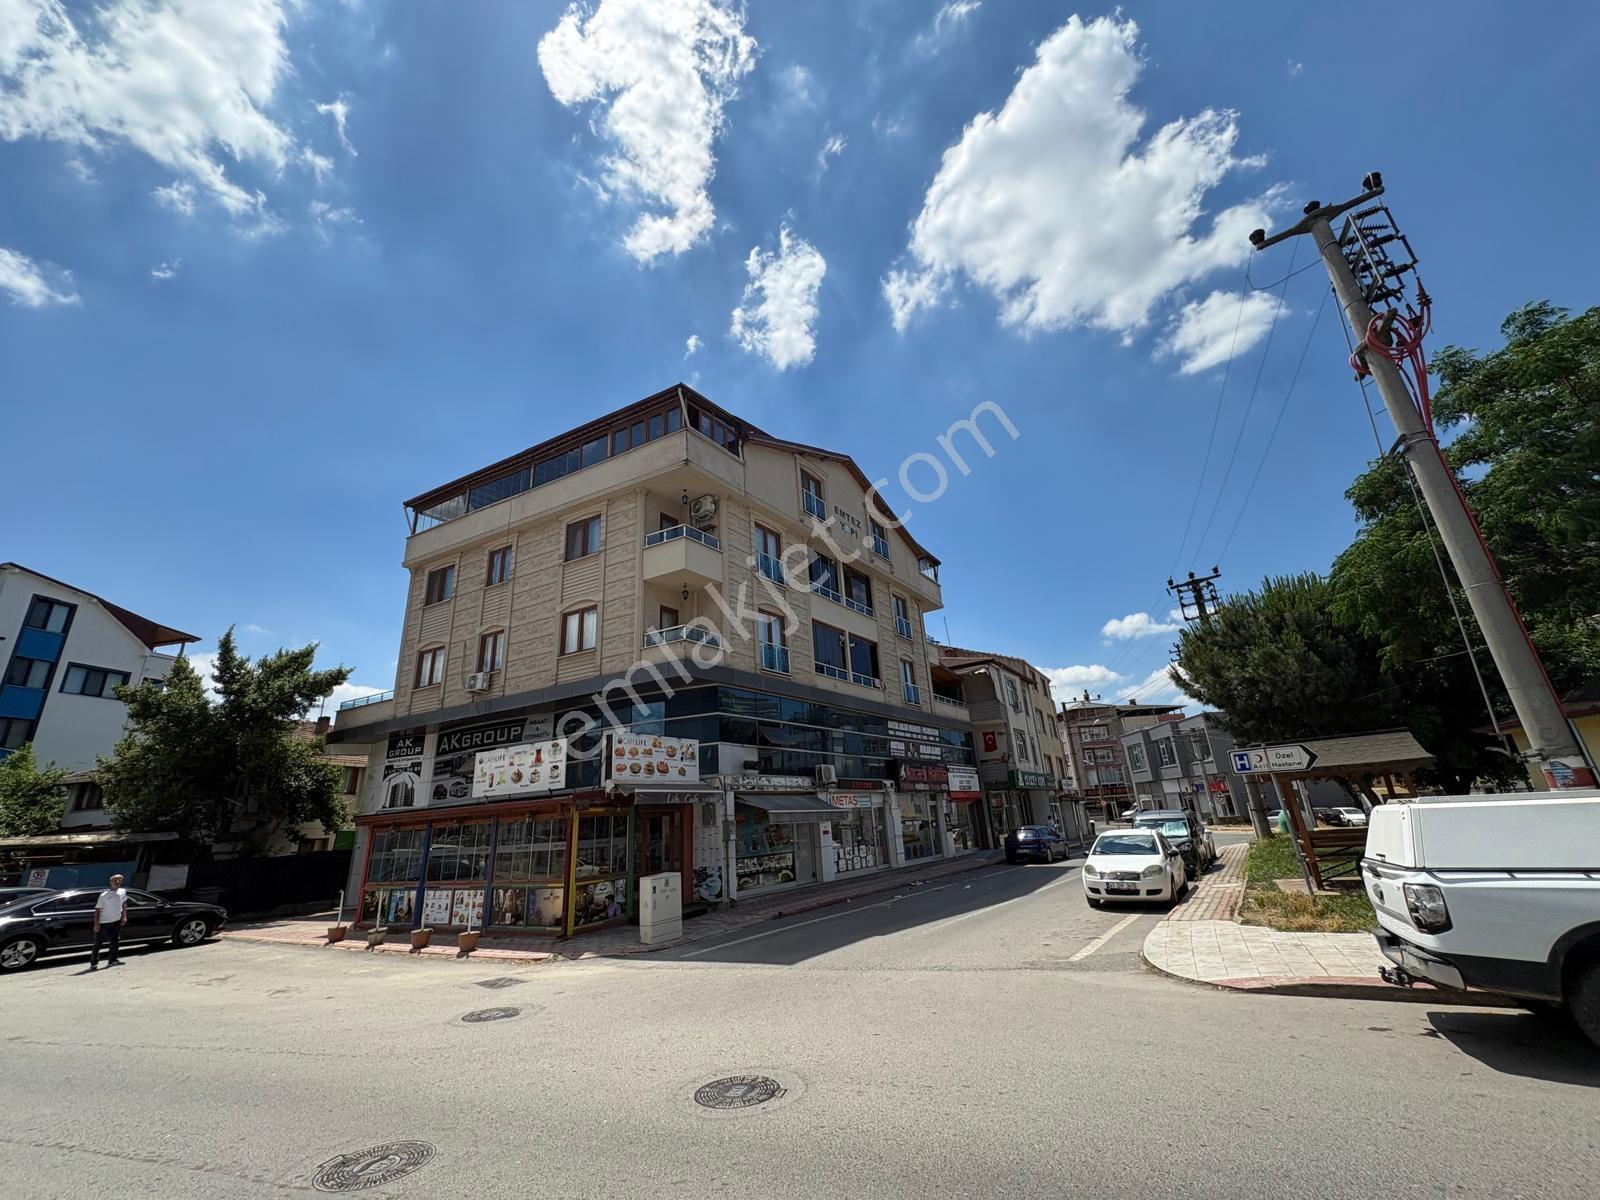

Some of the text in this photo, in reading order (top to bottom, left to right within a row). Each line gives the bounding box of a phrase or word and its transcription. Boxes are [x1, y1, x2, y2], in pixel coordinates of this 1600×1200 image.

[834, 505, 861, 529] EMTEZ
[396, 738, 413, 748] AK
[388, 746, 421, 757] GROUP
[832, 795, 858, 807] METAŞ
